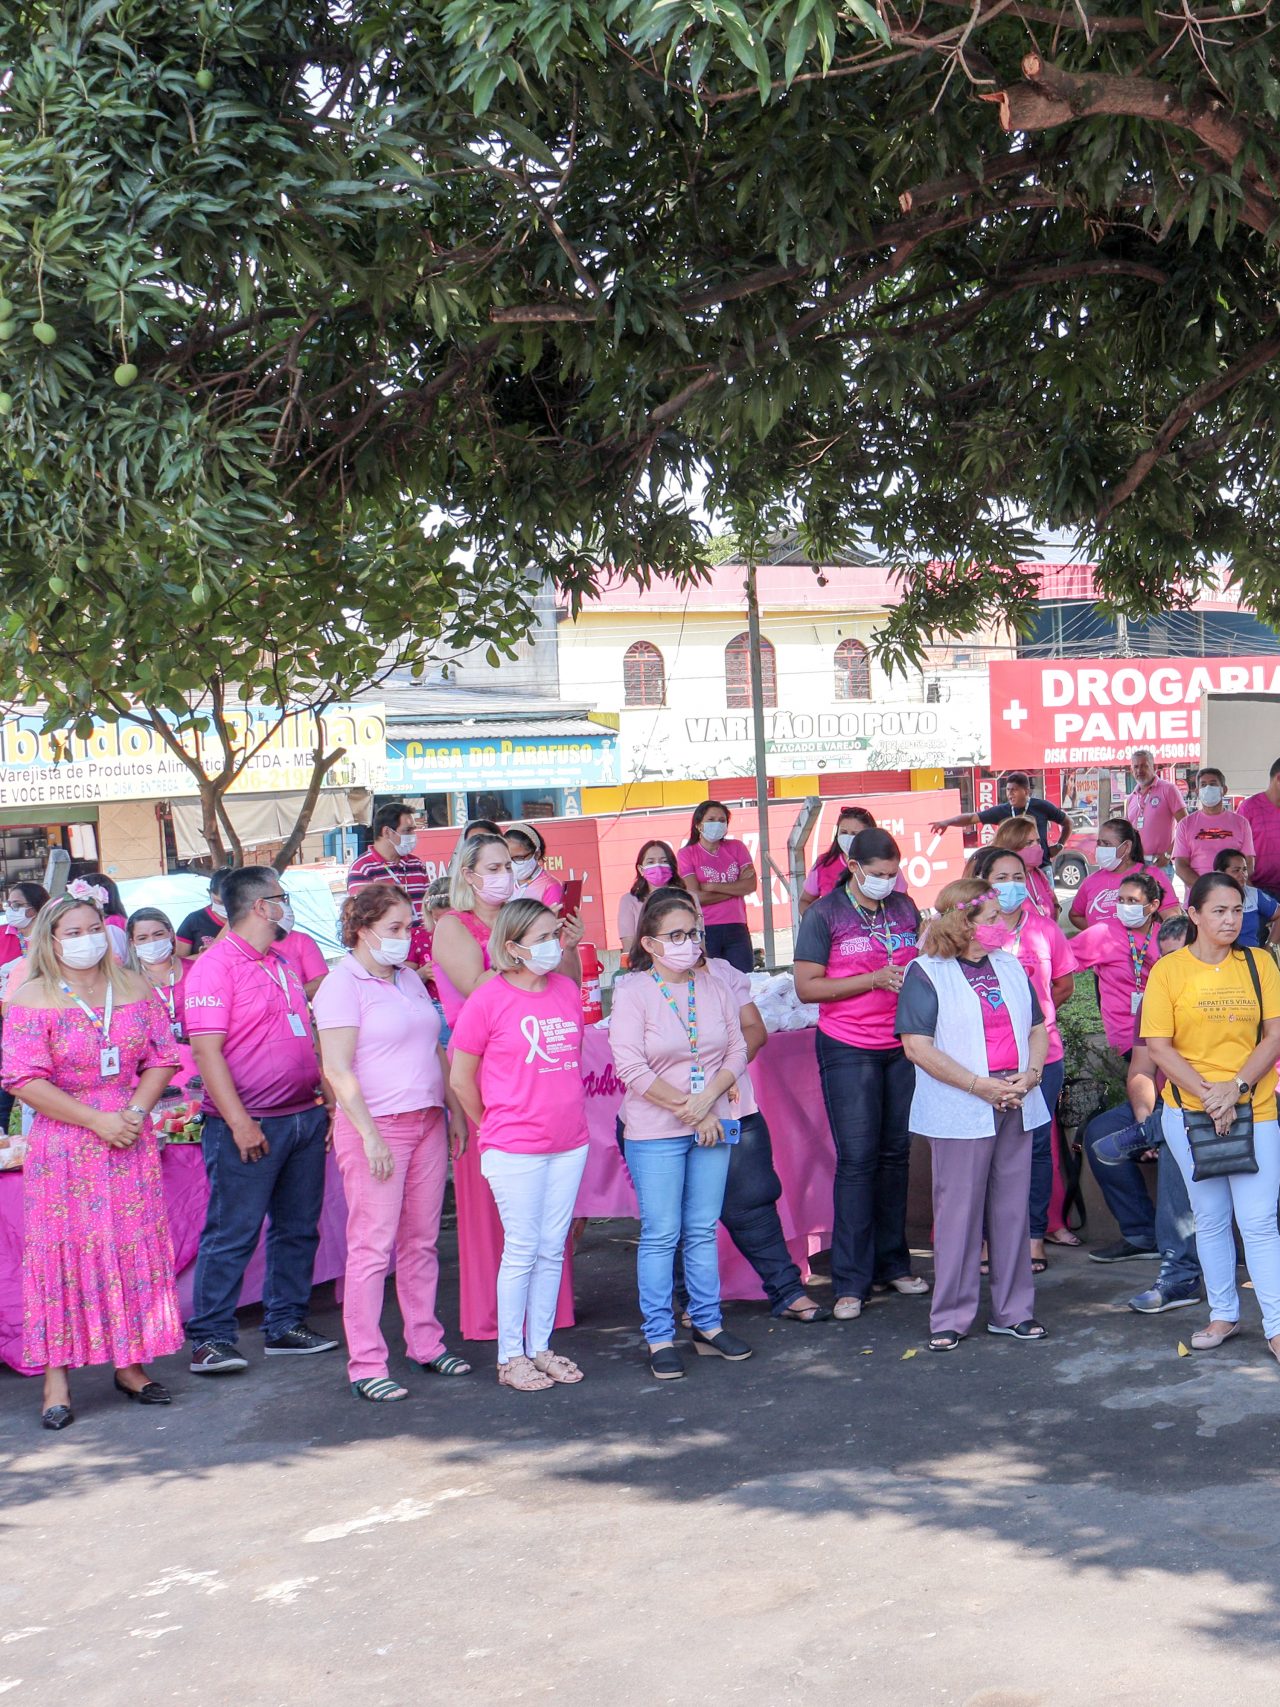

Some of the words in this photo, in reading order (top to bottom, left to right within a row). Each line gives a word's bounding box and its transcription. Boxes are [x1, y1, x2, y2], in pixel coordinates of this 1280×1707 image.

[817, 712, 859, 738] DO
[863, 711, 938, 737] POVO
[1054, 710, 1200, 743] PAME
[406, 741, 463, 770] CASA
[469, 746, 496, 768] DO
[501, 740, 593, 766] PARAFUSO
[769, 741, 815, 753] ATACADO
[823, 740, 862, 751] VAREJO
[1044, 748, 1068, 764] DISK
[67, 764, 83, 778] de
[88, 762, 153, 777] Produtos
[248, 754, 281, 769] LTDA
[12, 786, 45, 802] VOCE
[50, 784, 101, 801] PRECISA
[840, 942, 872, 956] ROSA
[184, 995, 225, 1010] SEMSA
[1198, 999, 1235, 1007] HEPATITES
